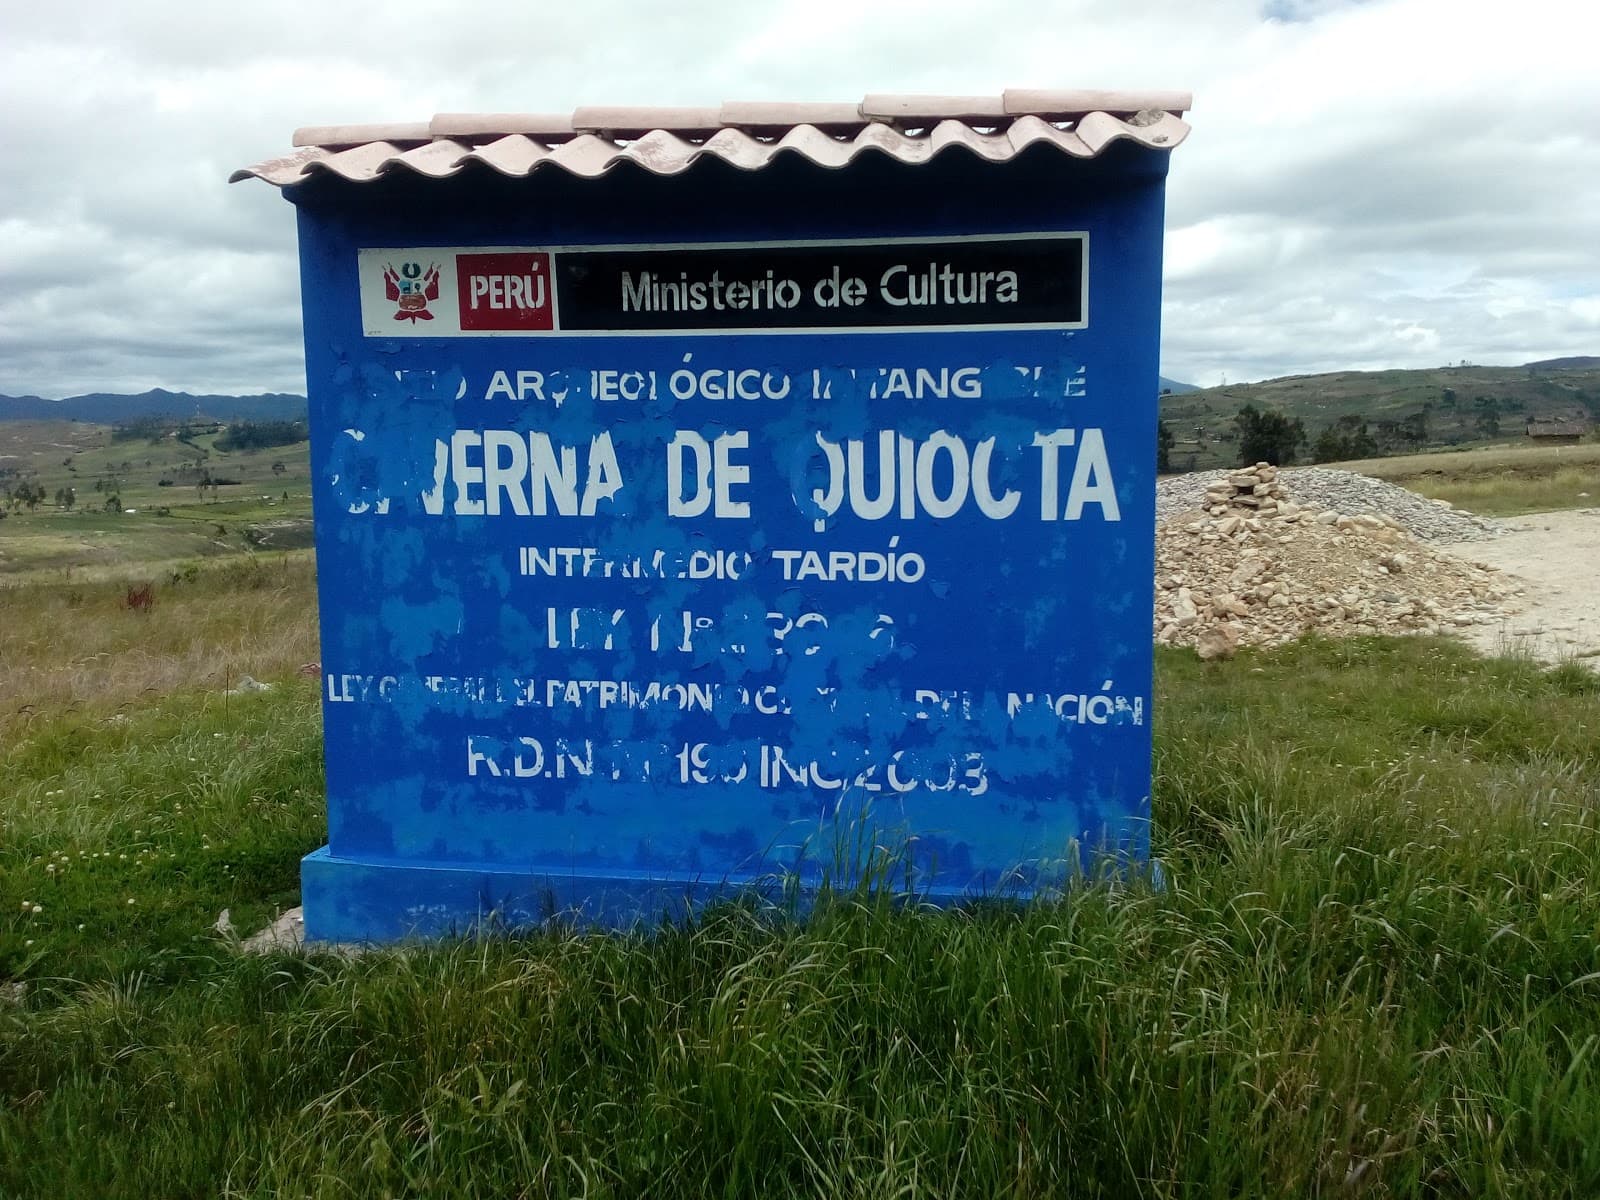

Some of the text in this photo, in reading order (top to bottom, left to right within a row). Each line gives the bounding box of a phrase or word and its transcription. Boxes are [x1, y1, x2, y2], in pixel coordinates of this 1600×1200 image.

[470, 261, 546, 311] PERÚ
[621, 262, 1019, 313] Ministerio de Cultura
[667, 429, 751, 519] DE
[772, 536, 926, 583] TARDÍO
